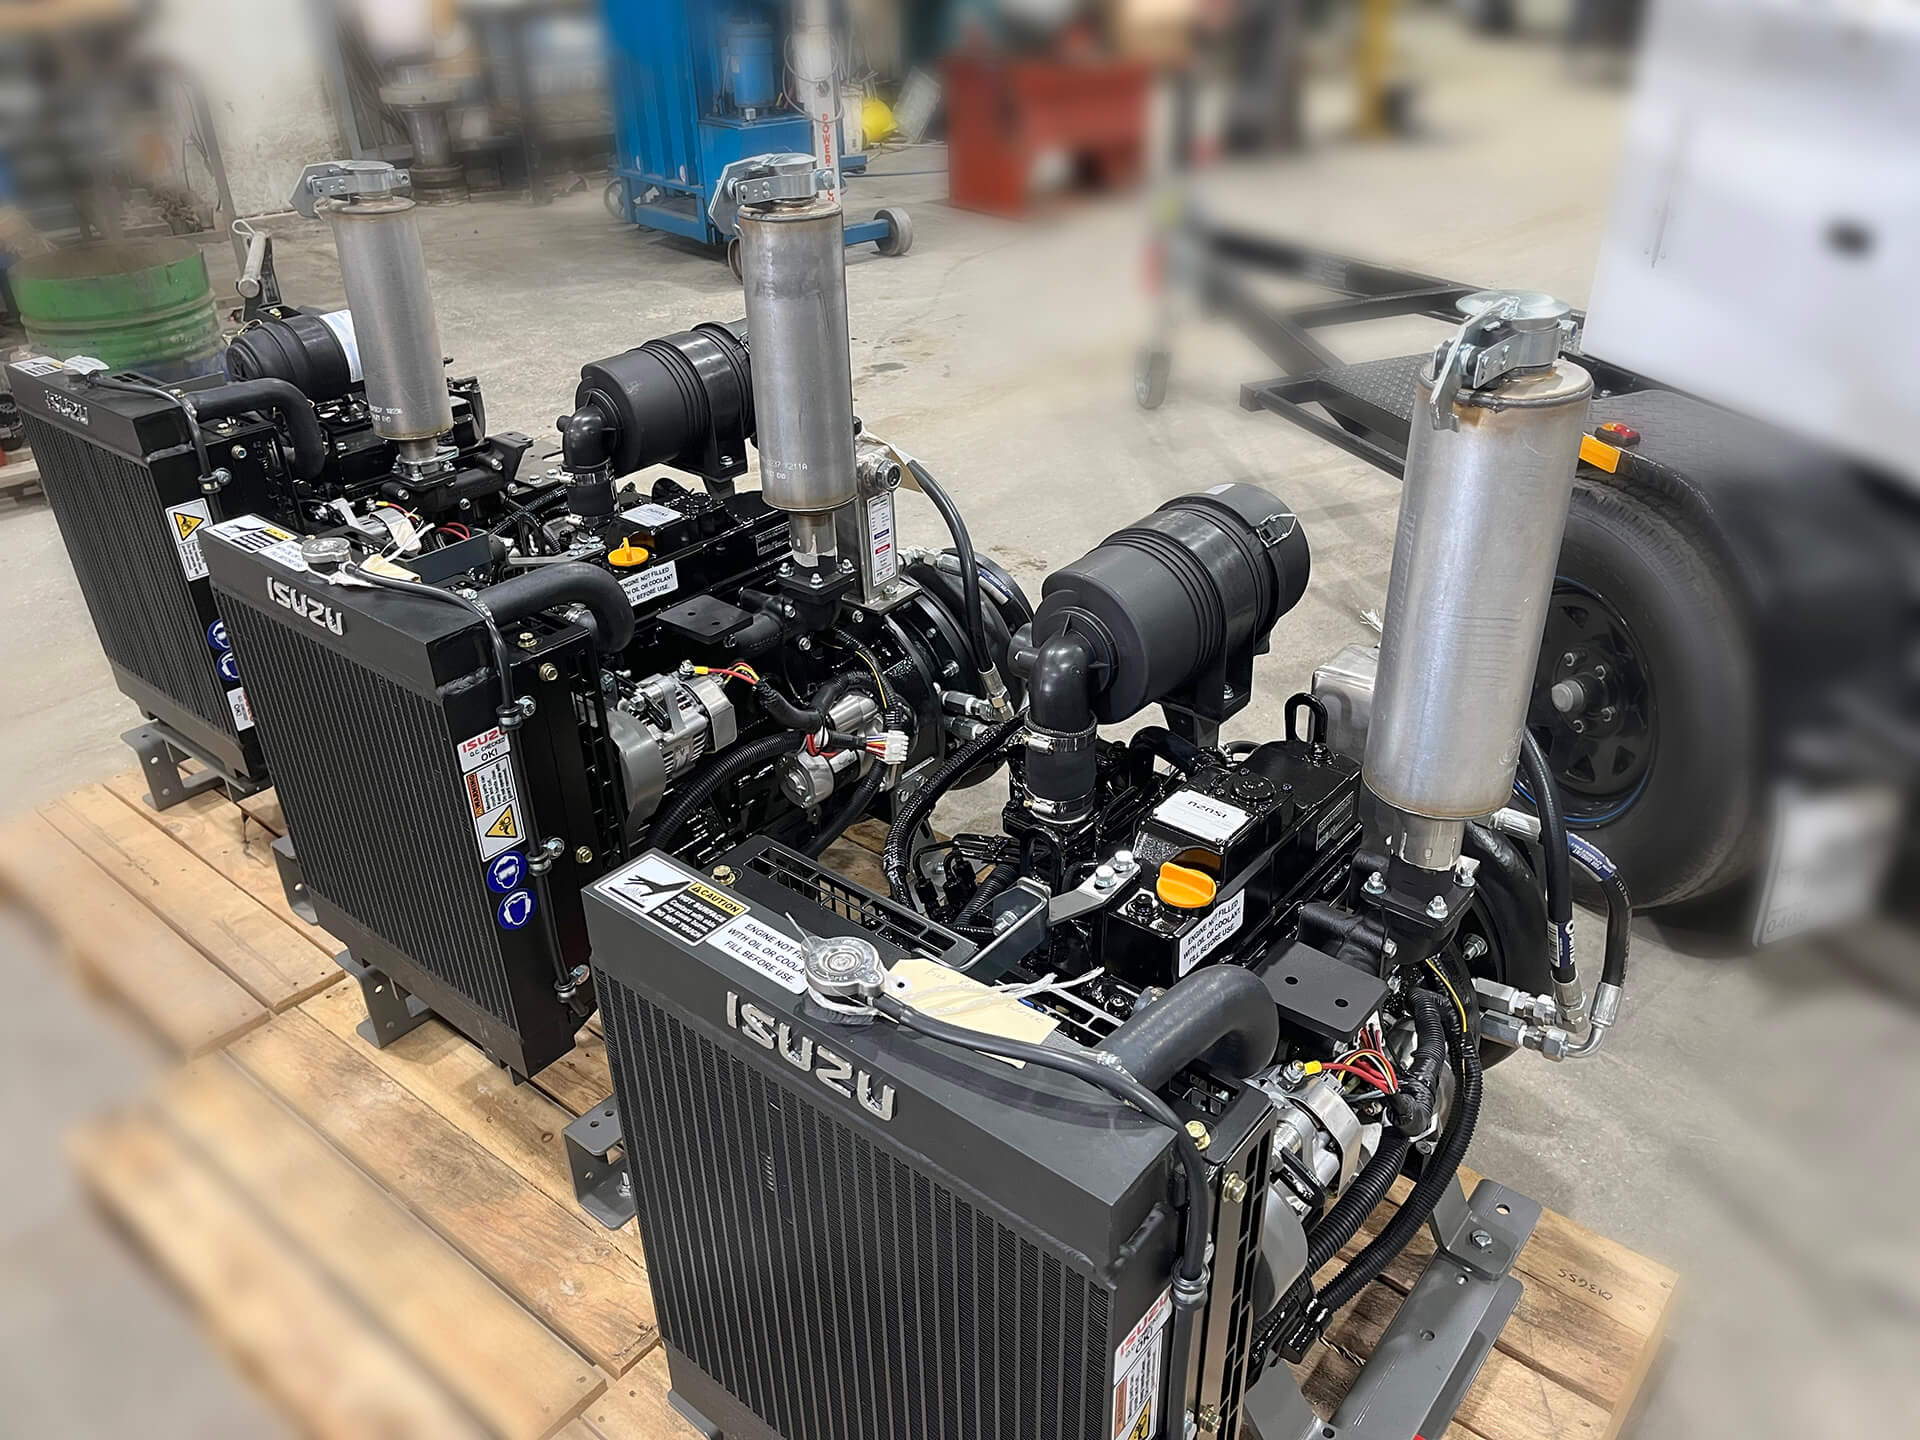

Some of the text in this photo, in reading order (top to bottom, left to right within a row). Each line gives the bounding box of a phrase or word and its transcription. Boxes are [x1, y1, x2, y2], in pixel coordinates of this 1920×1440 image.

[649, 574, 673, 586] COOLANT
[266, 576, 345, 637] ISUZU
[481, 748, 498, 761] OK!
[677, 894, 727, 923] HOT SURFACE
[700, 888, 741, 913] CAUTION
[654, 909, 703, 939] DO NOT TOUCH
[744, 923, 776, 943] ENGINE
[775, 940, 795, 952] NOT
[725, 940, 743, 953] FILL
[742, 950, 777, 972] BEFORE
[728, 928, 750, 942] WITH
[748, 939, 762, 950] OIL
[762, 947, 776, 958] OR
[726, 990, 897, 1122] ISUZU
